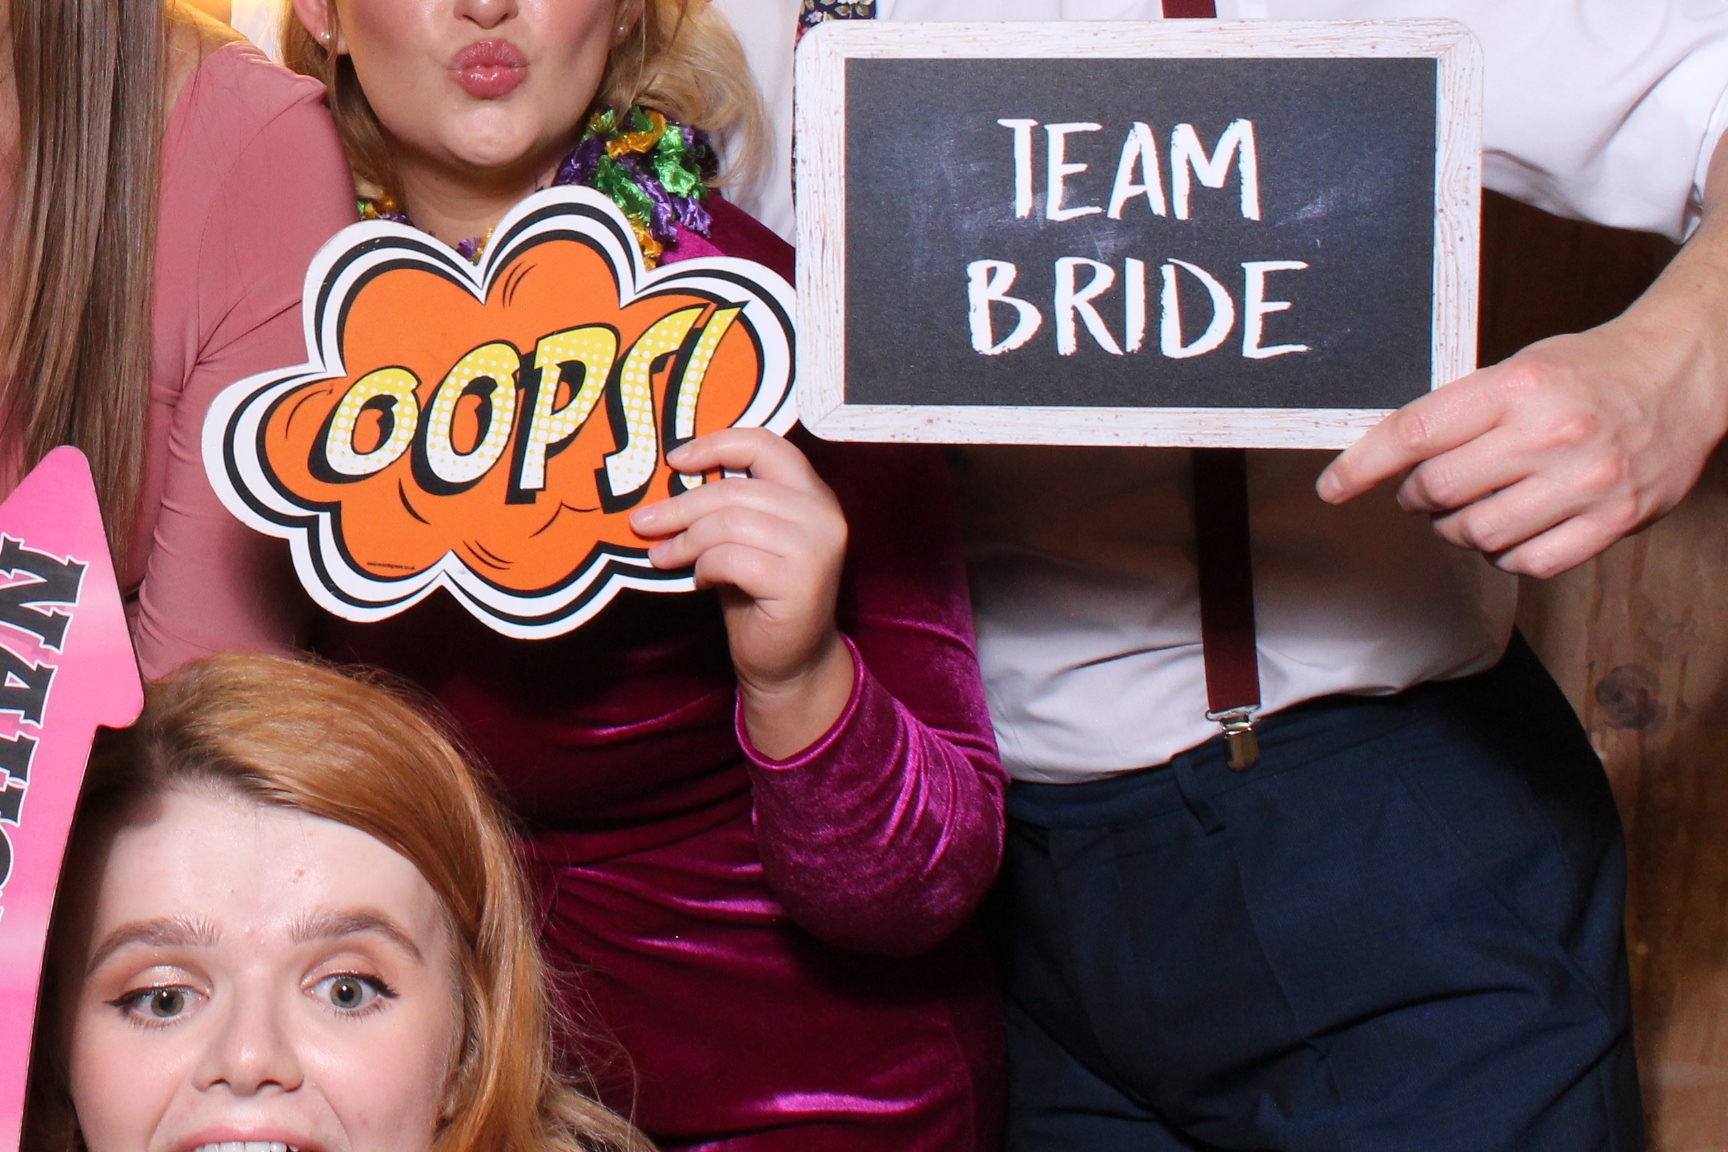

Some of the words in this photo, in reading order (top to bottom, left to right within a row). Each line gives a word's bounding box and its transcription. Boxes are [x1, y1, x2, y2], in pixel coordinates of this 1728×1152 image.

[996, 118, 1262, 221] TEAM
[967, 257, 1312, 361] BRIDE
[308, 300, 752, 515] OOPS!
